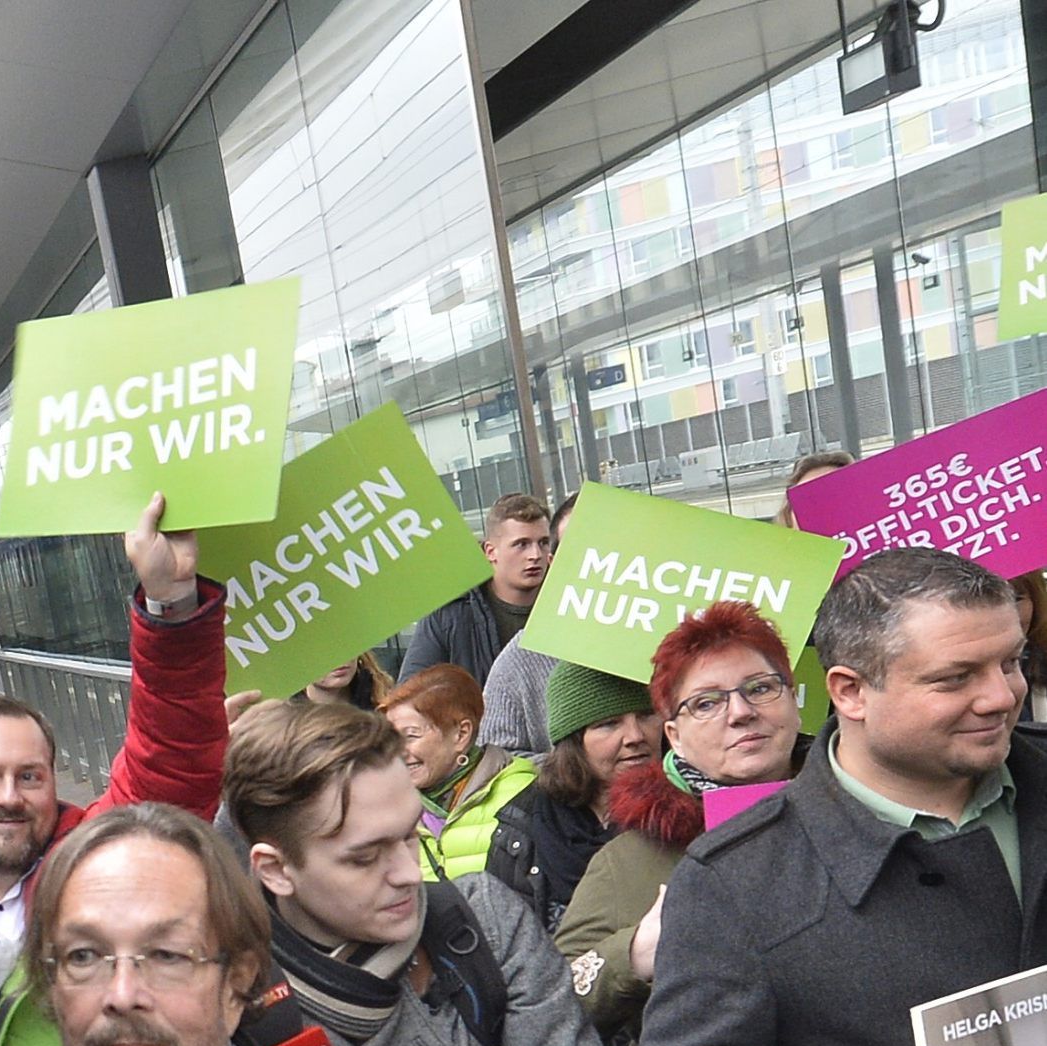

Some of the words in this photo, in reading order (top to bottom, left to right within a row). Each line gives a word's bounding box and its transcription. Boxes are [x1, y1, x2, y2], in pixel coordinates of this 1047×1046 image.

[38, 347, 257, 437] MACHEN
[26, 430, 134, 487] NUR
[148, 403, 266, 464] WIR.
[882, 453, 974, 509] 365€
[939, 484, 1042, 541] DICH.
[223, 466, 407, 625] MACHEN
[224, 581, 331, 669] NUR
[324, 507, 443, 589] WIR.
[557, 584, 660, 633] NUR
[577, 547, 792, 614] MACHEN
[942, 1009, 1003, 1042] HELGA
